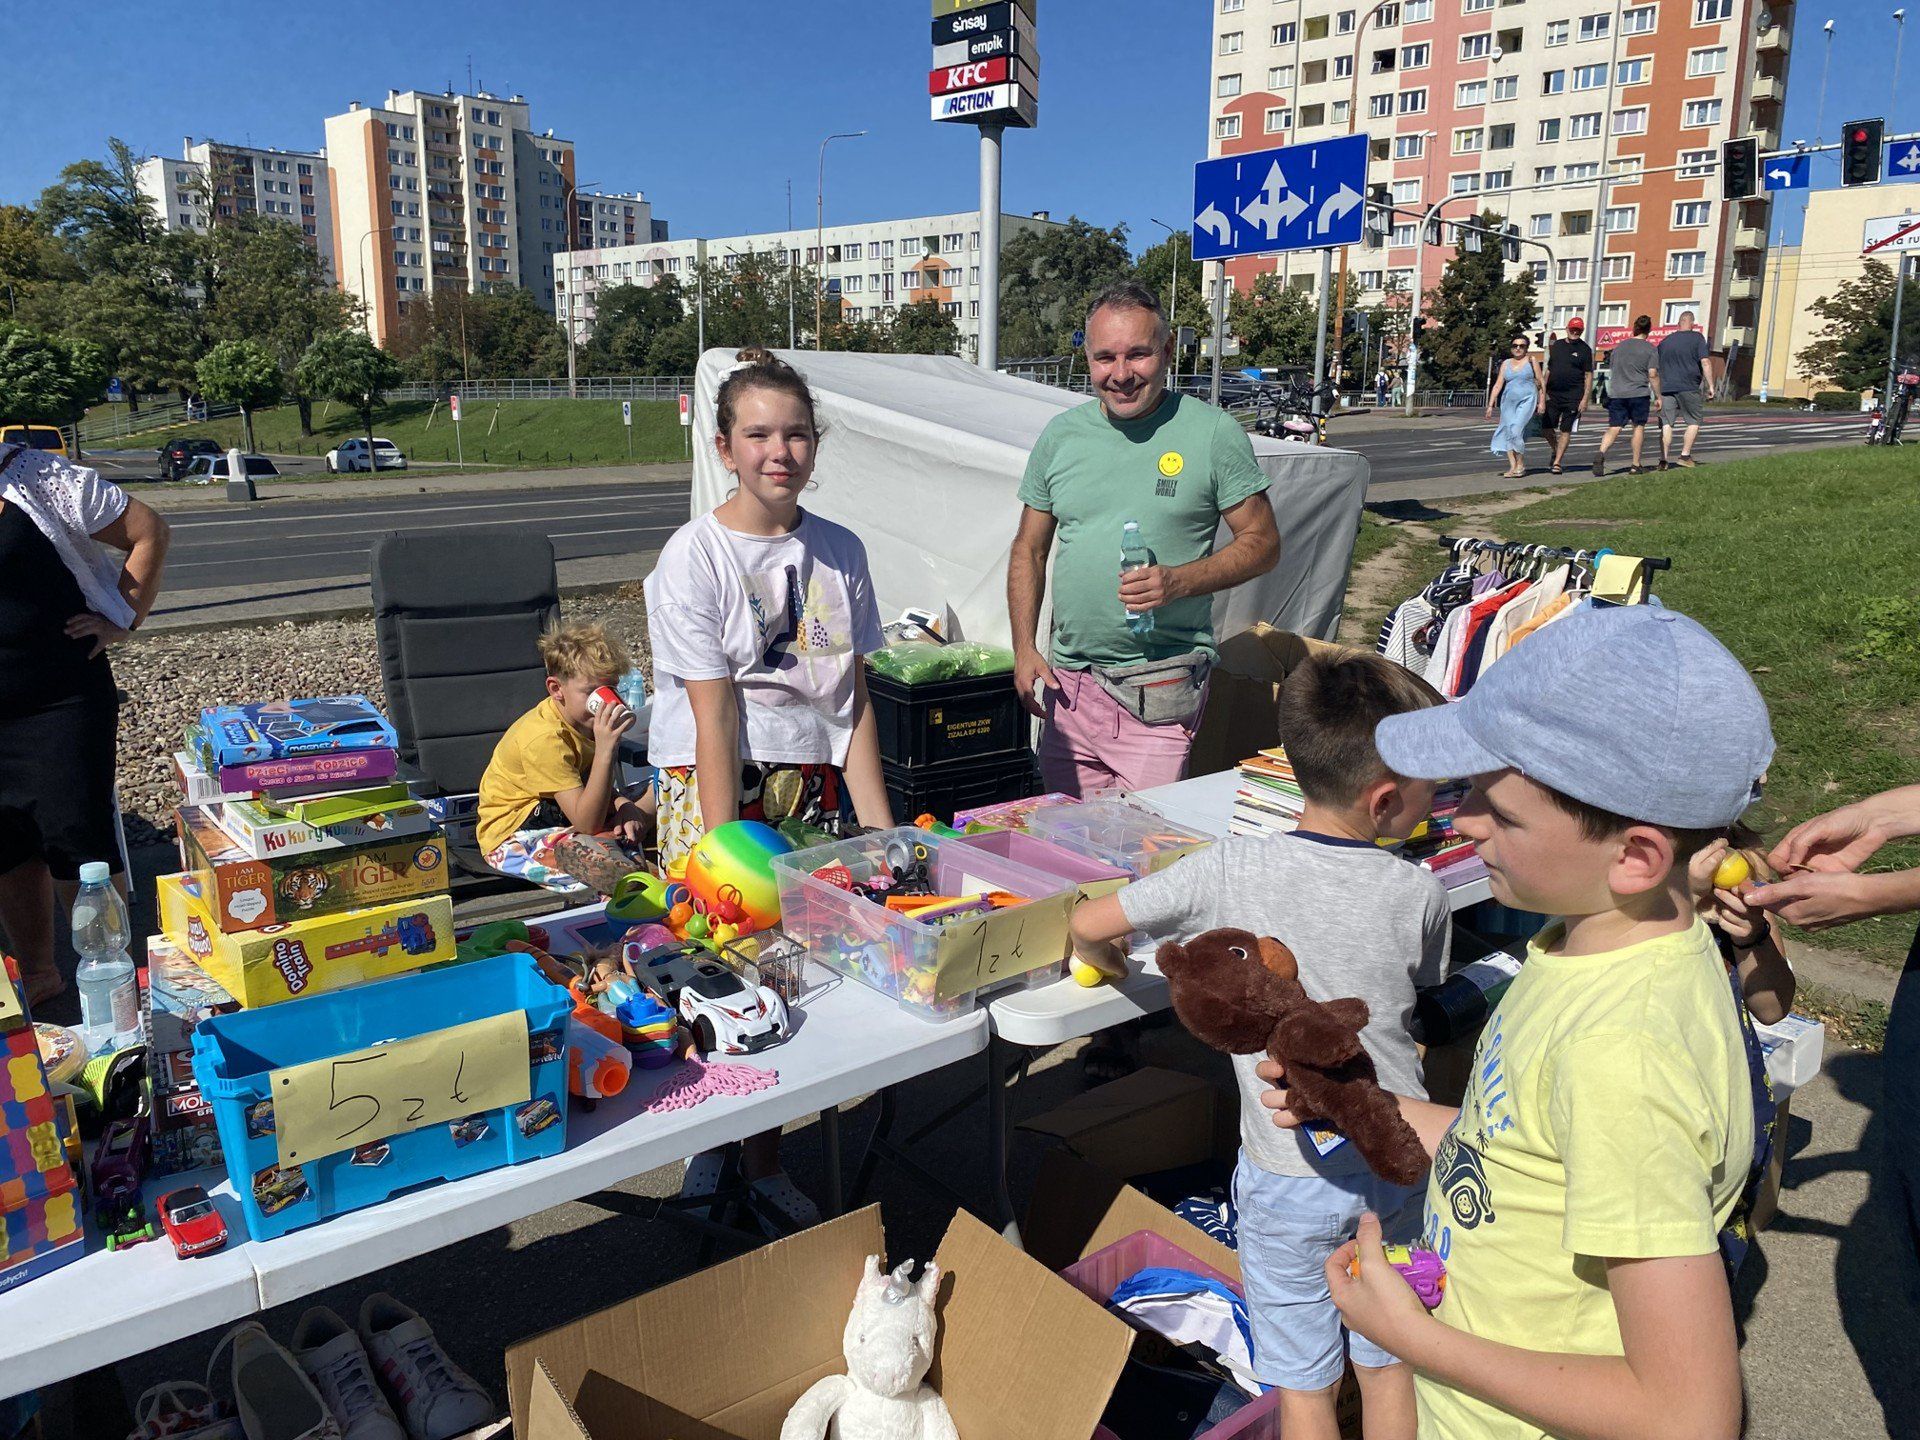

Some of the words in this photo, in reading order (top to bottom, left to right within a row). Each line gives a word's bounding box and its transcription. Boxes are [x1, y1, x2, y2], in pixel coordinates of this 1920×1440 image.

[952, 14, 987, 33] sinsay
[971, 35, 1004, 55] empik
[946, 62, 988, 89] KFC
[949, 90, 995, 114] ACTION
[1155, 487, 1176, 497] WORLD
[224, 872, 266, 888] TIGER
[338, 861, 409, 889] TIGER
[275, 942, 304, 992] Domino
[290, 944, 310, 978] Train
